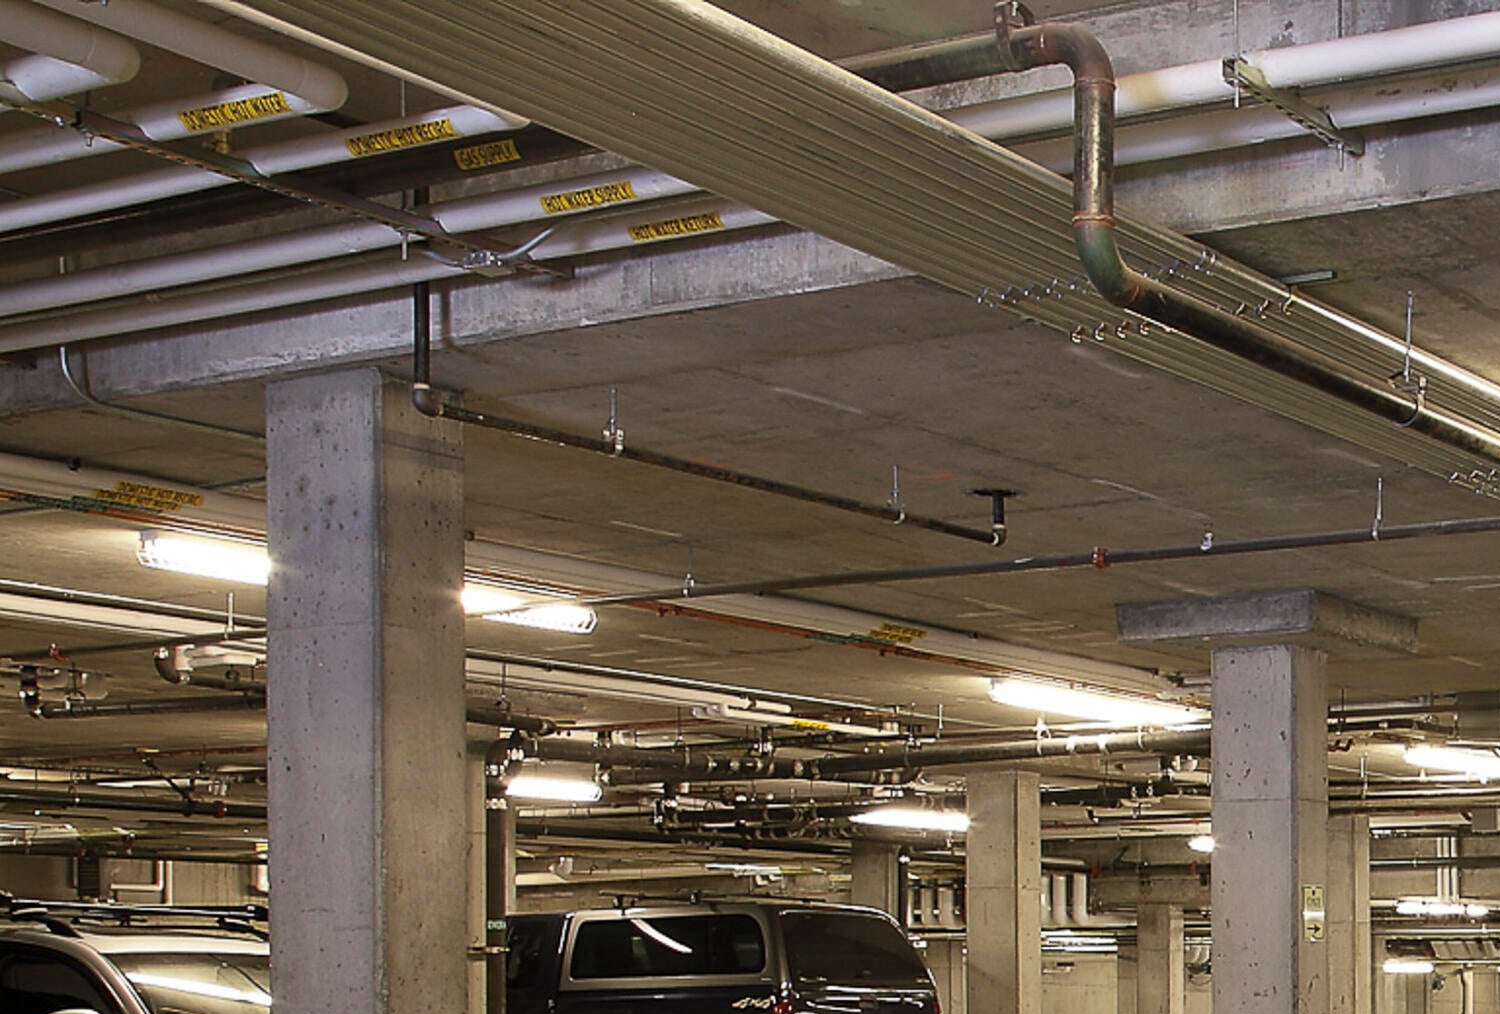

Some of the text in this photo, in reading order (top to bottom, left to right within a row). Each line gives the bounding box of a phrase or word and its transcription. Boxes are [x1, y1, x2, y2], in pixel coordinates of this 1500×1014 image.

[229, 100, 250, 122] HOT
[542, 194, 565, 212] HOT
[564, 189, 594, 209] WATER
[631, 223, 653, 240] HOT
